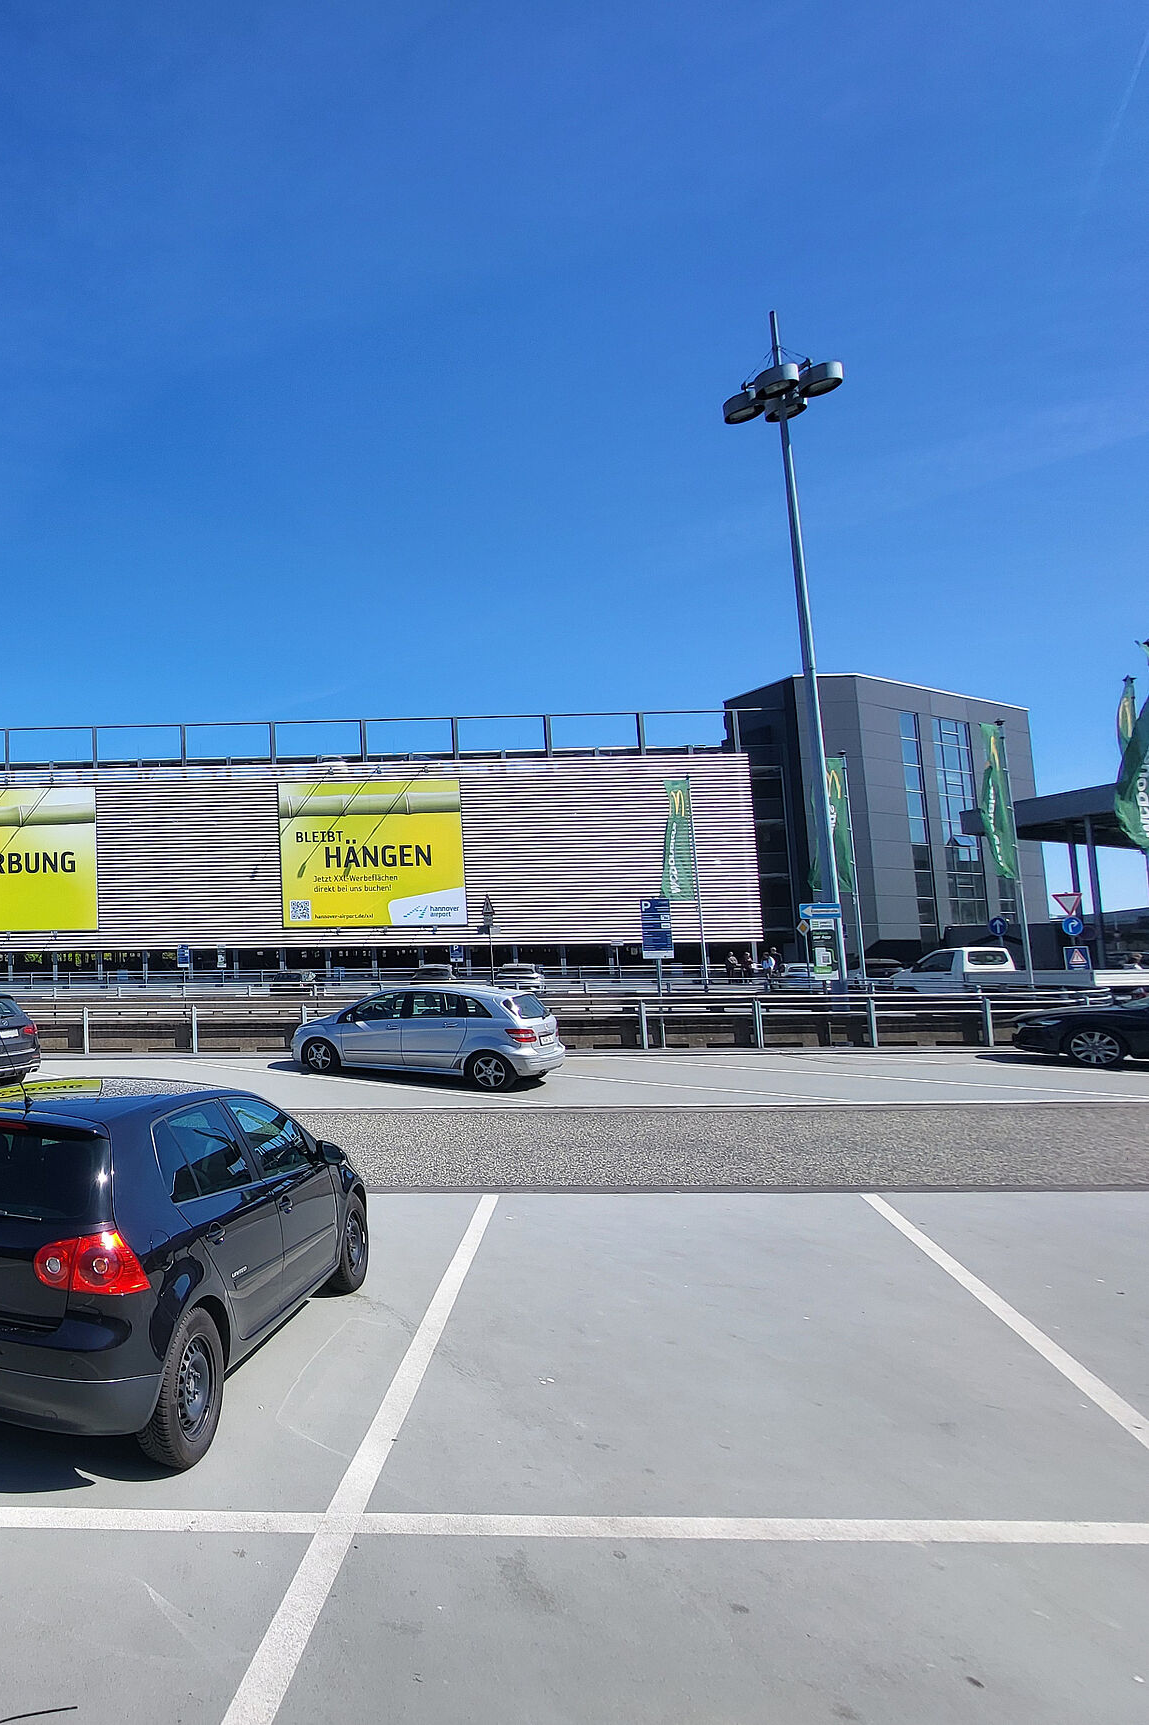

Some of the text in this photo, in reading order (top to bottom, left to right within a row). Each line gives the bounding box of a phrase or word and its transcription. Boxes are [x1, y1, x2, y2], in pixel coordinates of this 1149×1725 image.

[295, 831, 343, 843] BLEIBT
[325, 839, 432, 868] HÄNGEN
[313, 874, 398, 883] Jetzt XXL-Werbeflächen
[313, 885, 335, 893] direkt
[364, 884, 392, 892] buchen!
[641, 900, 651, 912] P
